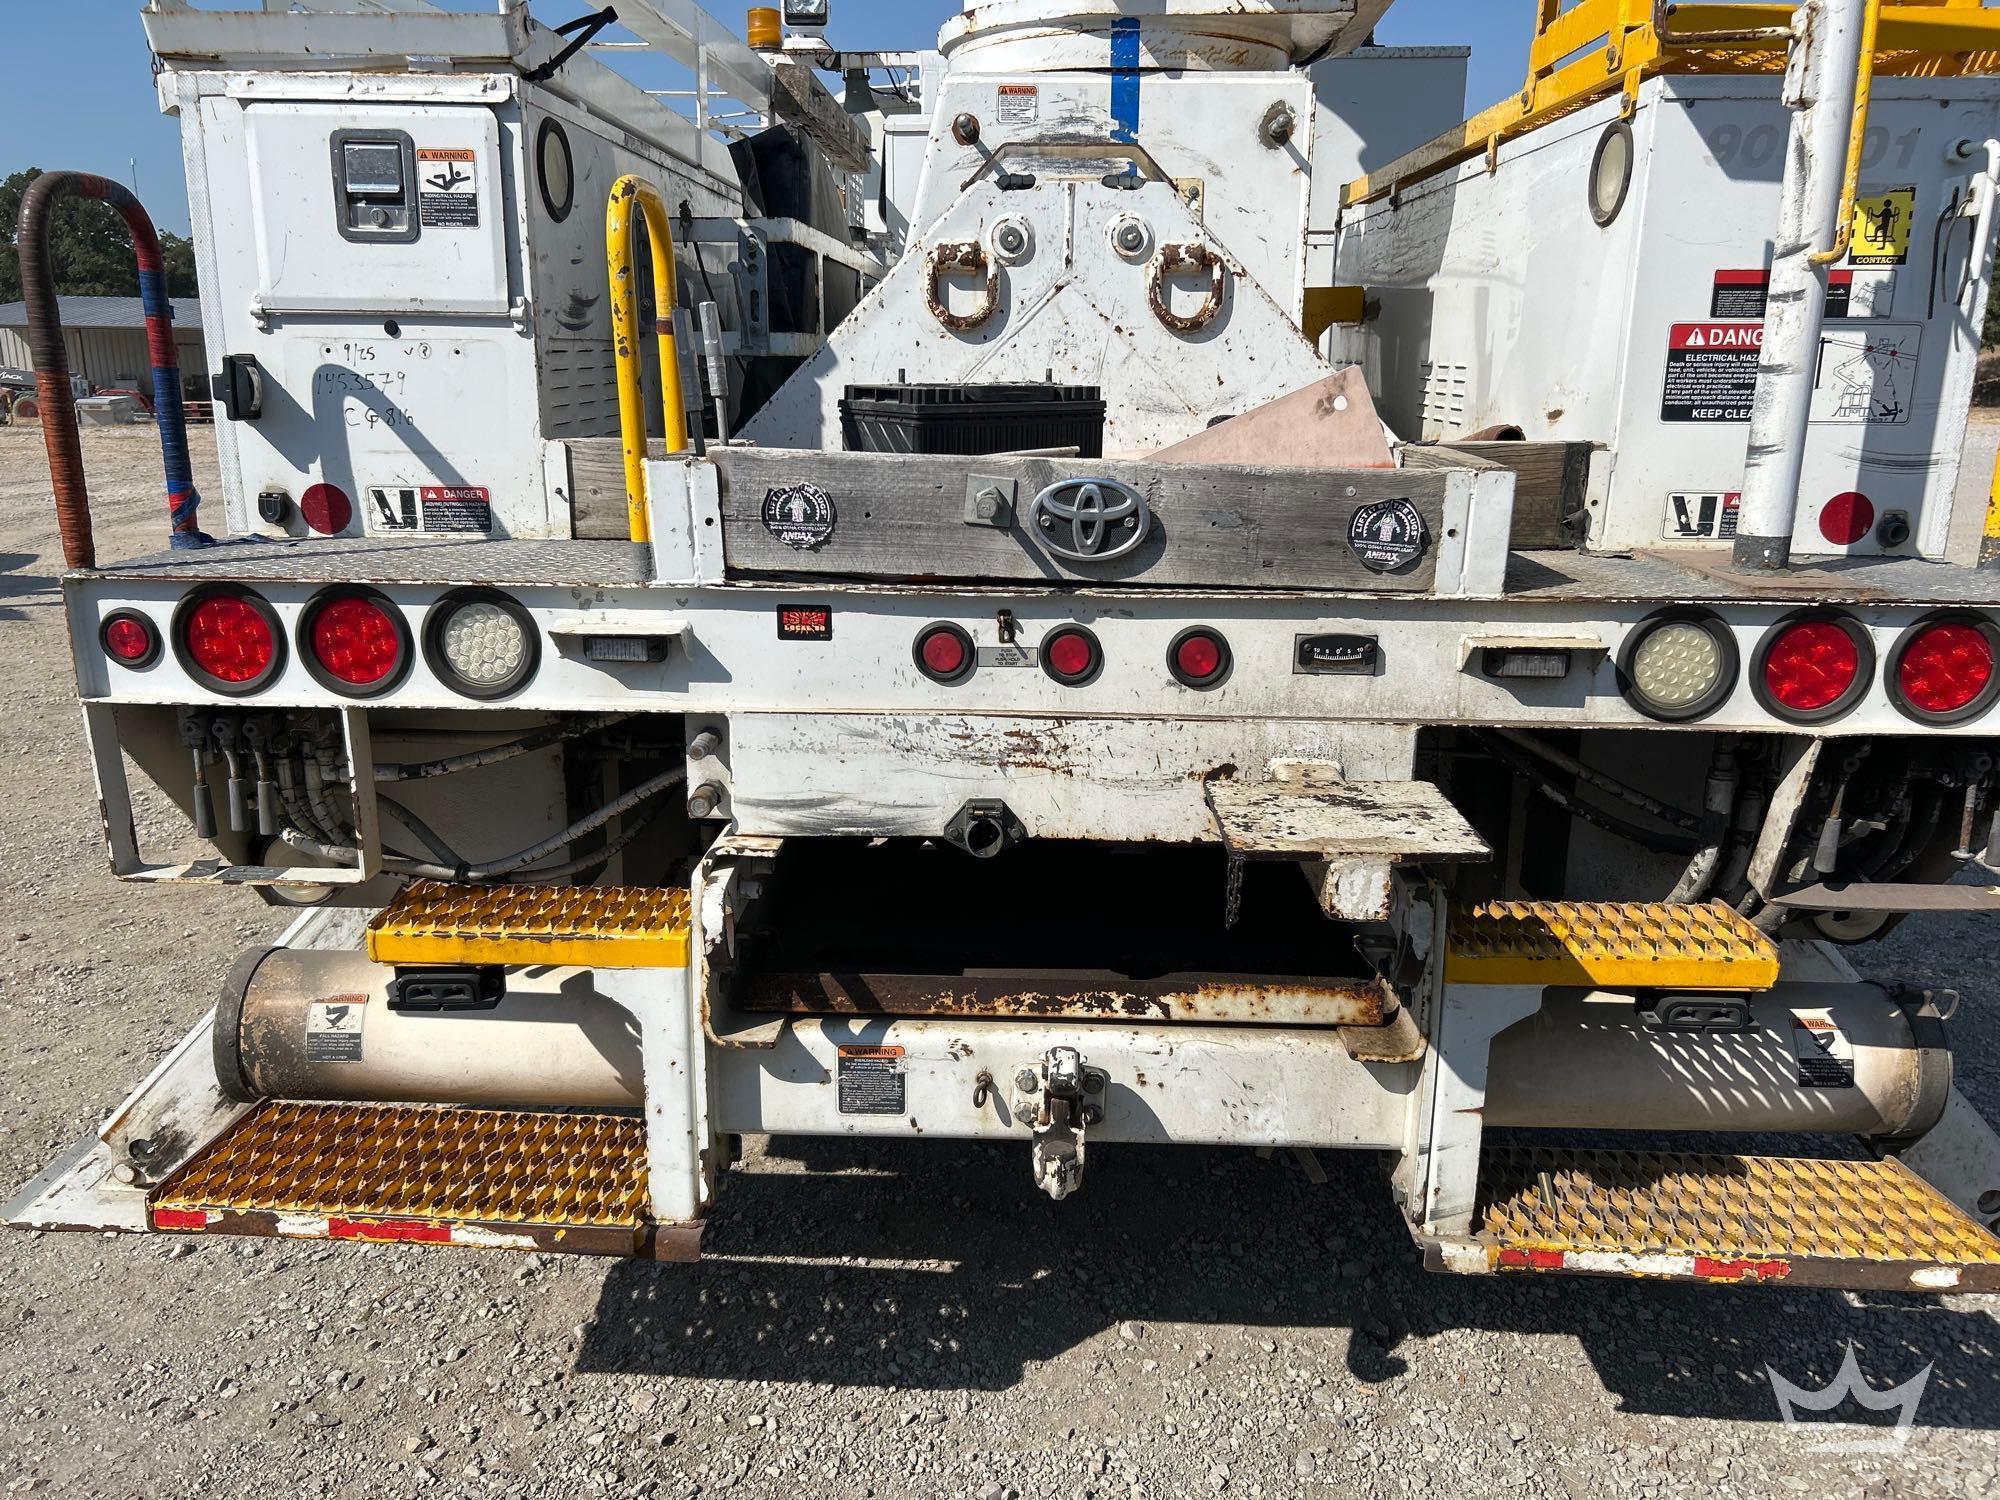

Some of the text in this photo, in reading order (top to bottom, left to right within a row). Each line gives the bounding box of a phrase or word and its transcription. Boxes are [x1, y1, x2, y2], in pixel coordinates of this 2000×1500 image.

[1856, 256, 1898, 265] CONTACT
[1709, 329, 1763, 345] DANG
[1685, 354, 1760, 362] ELECTRICAL HAZ
[0, 371, 24, 381] JACK
[1692, 409, 1723, 418] KEEP
[443, 489, 484, 499] DANGER
[768, 495, 779, 514] LIFT
[814, 493, 827, 516] LUGS
[1356, 502, 1418, 536] LIFT IT BY THE LUGS
[780, 531, 814, 541] ANDAX
[1383, 545, 1415, 553] COMPLIANT
[1364, 550, 1399, 561] ANDAX
[853, 1048, 897, 1056] WARNING
